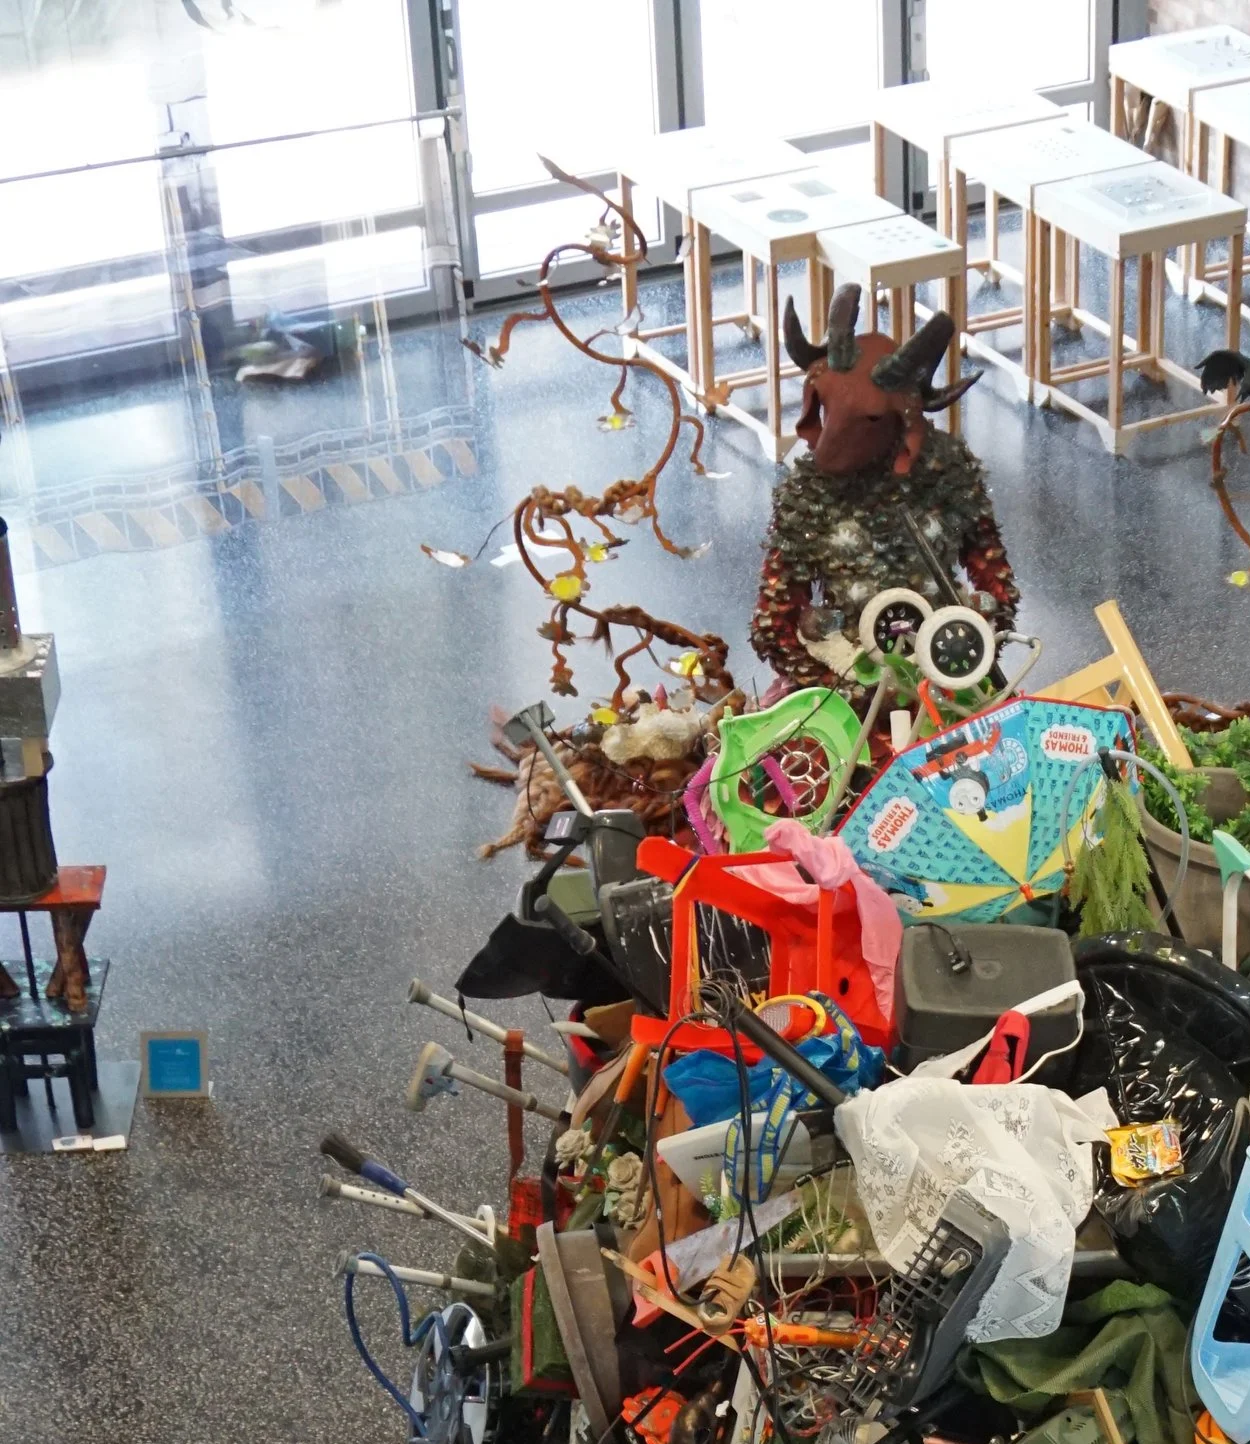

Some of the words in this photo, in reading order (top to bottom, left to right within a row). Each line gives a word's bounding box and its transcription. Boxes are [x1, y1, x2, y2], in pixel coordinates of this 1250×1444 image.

[1044, 739, 1089, 755] THOMAS
[1049, 731, 1081, 742] FRIENDS
[985, 787, 1028, 811] THOMAS
[872, 807, 898, 840] FRIENDS
[877, 806, 914, 849] THOMAS
